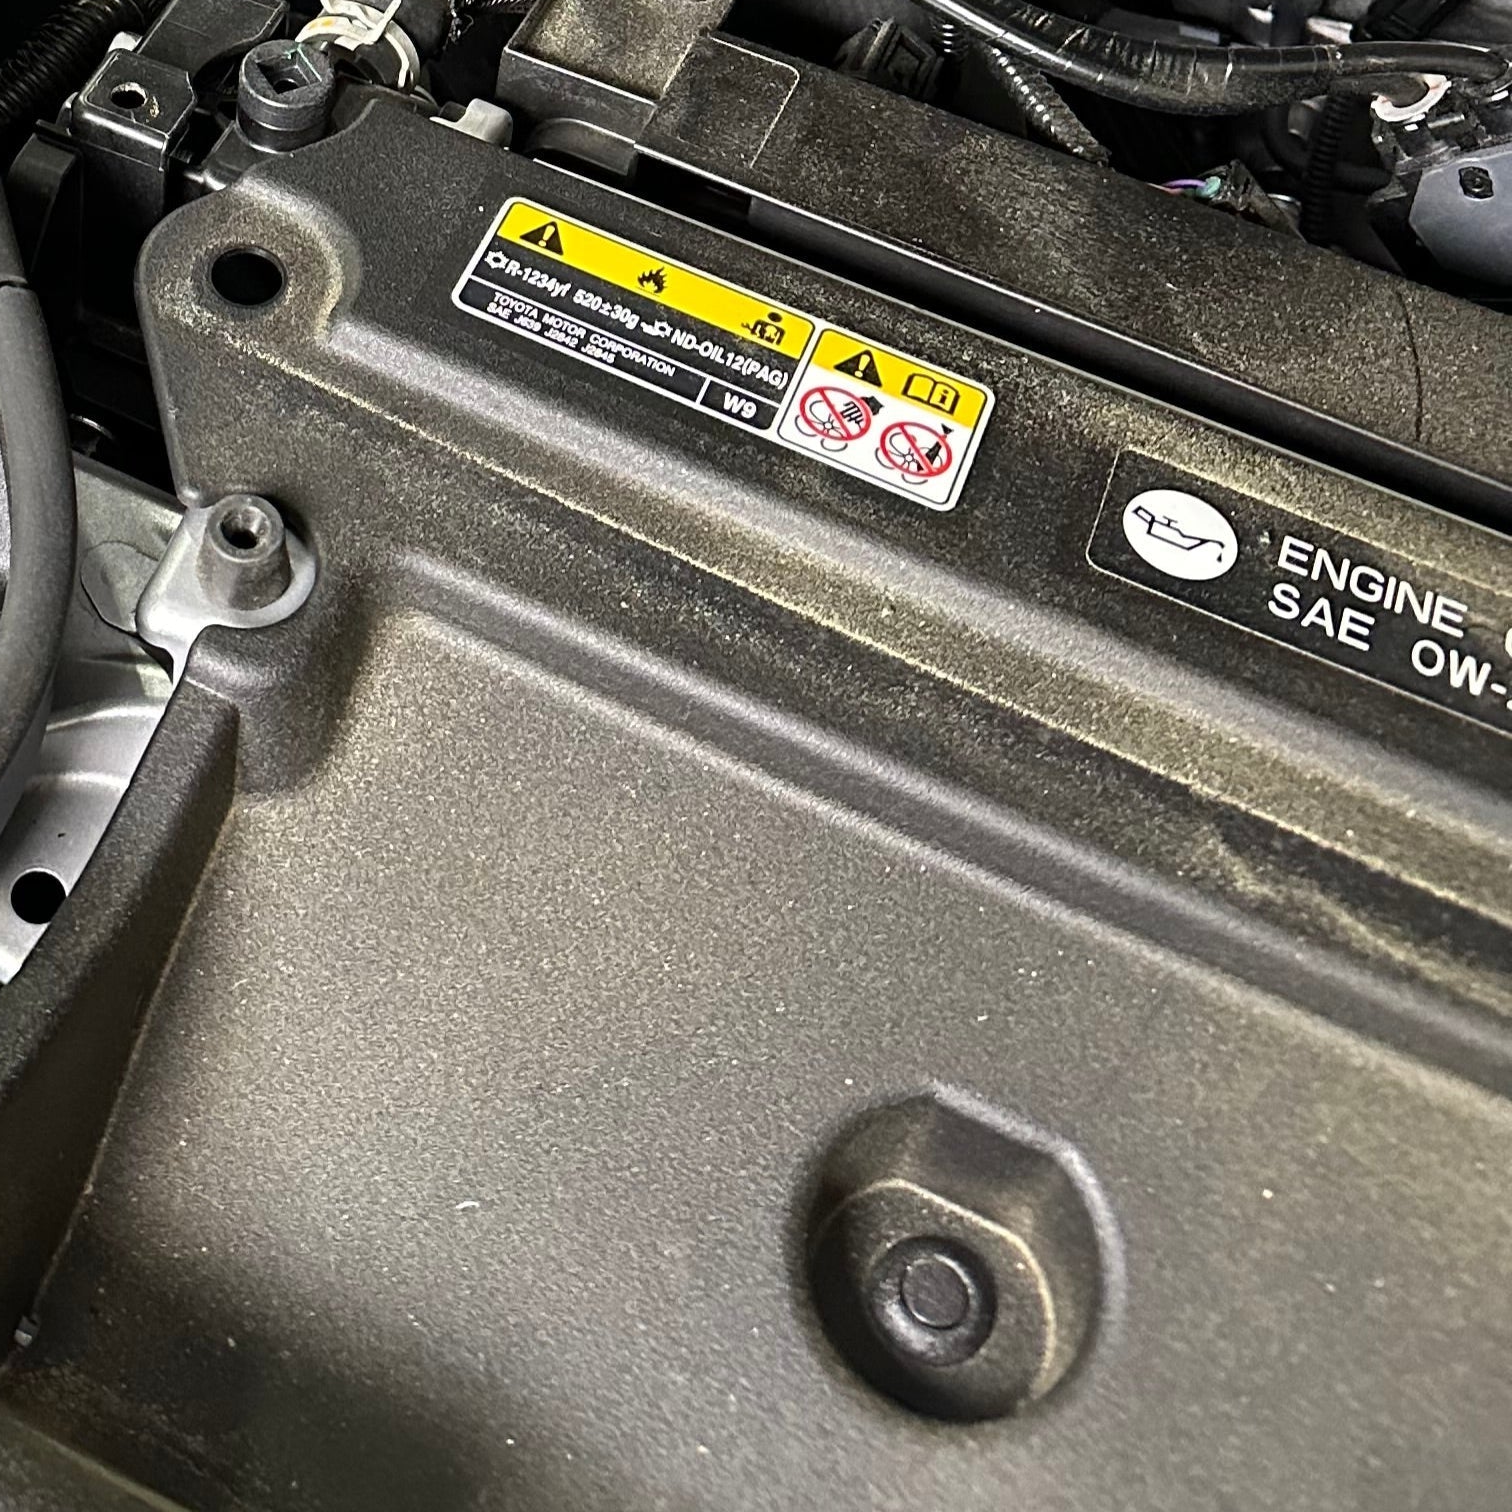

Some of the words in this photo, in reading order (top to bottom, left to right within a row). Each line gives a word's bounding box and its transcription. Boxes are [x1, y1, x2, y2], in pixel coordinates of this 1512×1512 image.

[486, 301, 513, 320] SAE
[493, 291, 539, 319] TOYOTA
[541, 312, 587, 339] MOTOR
[589, 333, 676, 377] CORPORATION
[723, 391, 758, 419] W9
[1267, 583, 1376, 652] SAE
[1277, 535, 1469, 638] ENGINE
